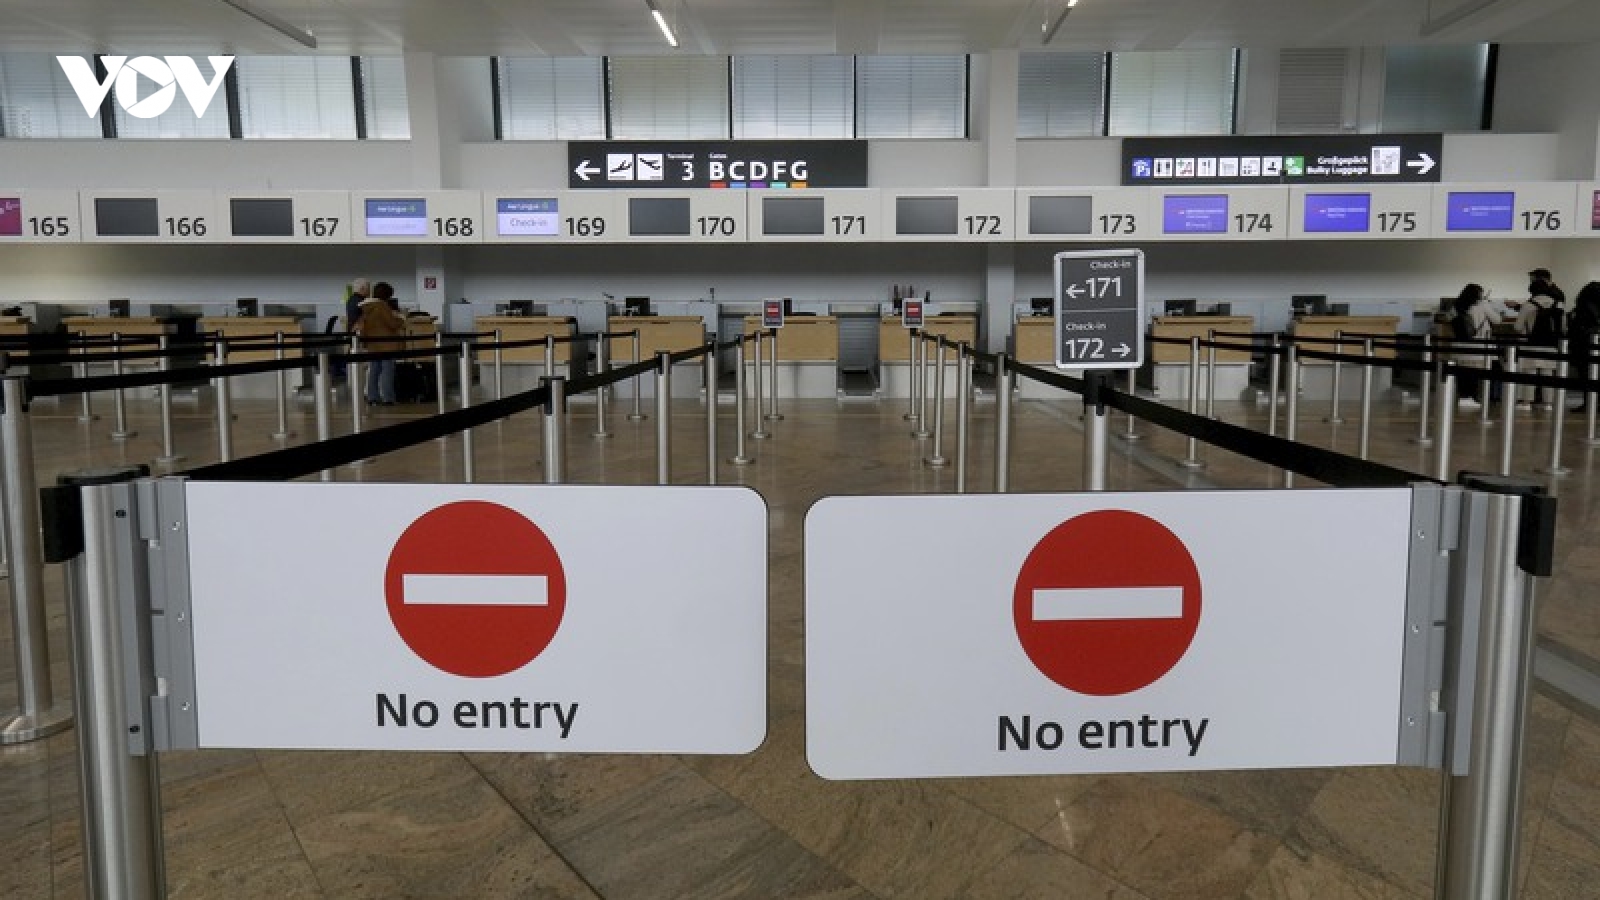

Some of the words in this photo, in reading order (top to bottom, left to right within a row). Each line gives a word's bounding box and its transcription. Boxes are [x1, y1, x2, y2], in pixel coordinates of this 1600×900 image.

[681, 161, 695, 181] 3
[28, 216, 69, 236] 165
[165, 217, 207, 237] 166
[300, 217, 339, 237] 167
[433, 217, 474, 237] 168
[565, 217, 606, 237] 169
[697, 216, 736, 236] 170
[831, 216, 866, 235] 171
[964, 216, 1002, 235] 172
[1099, 214, 1136, 234] 173
[1234, 213, 1274, 233] 174
[1377, 212, 1416, 232] 175
[1520, 210, 1561, 231] 176
[1086, 276, 1120, 298] 171
[1066, 338, 1104, 358] 172
[375, 693, 439, 728] No
[453, 697, 579, 739] entry
[997, 715, 1064, 751] No
[1078, 714, 1209, 757] entry
